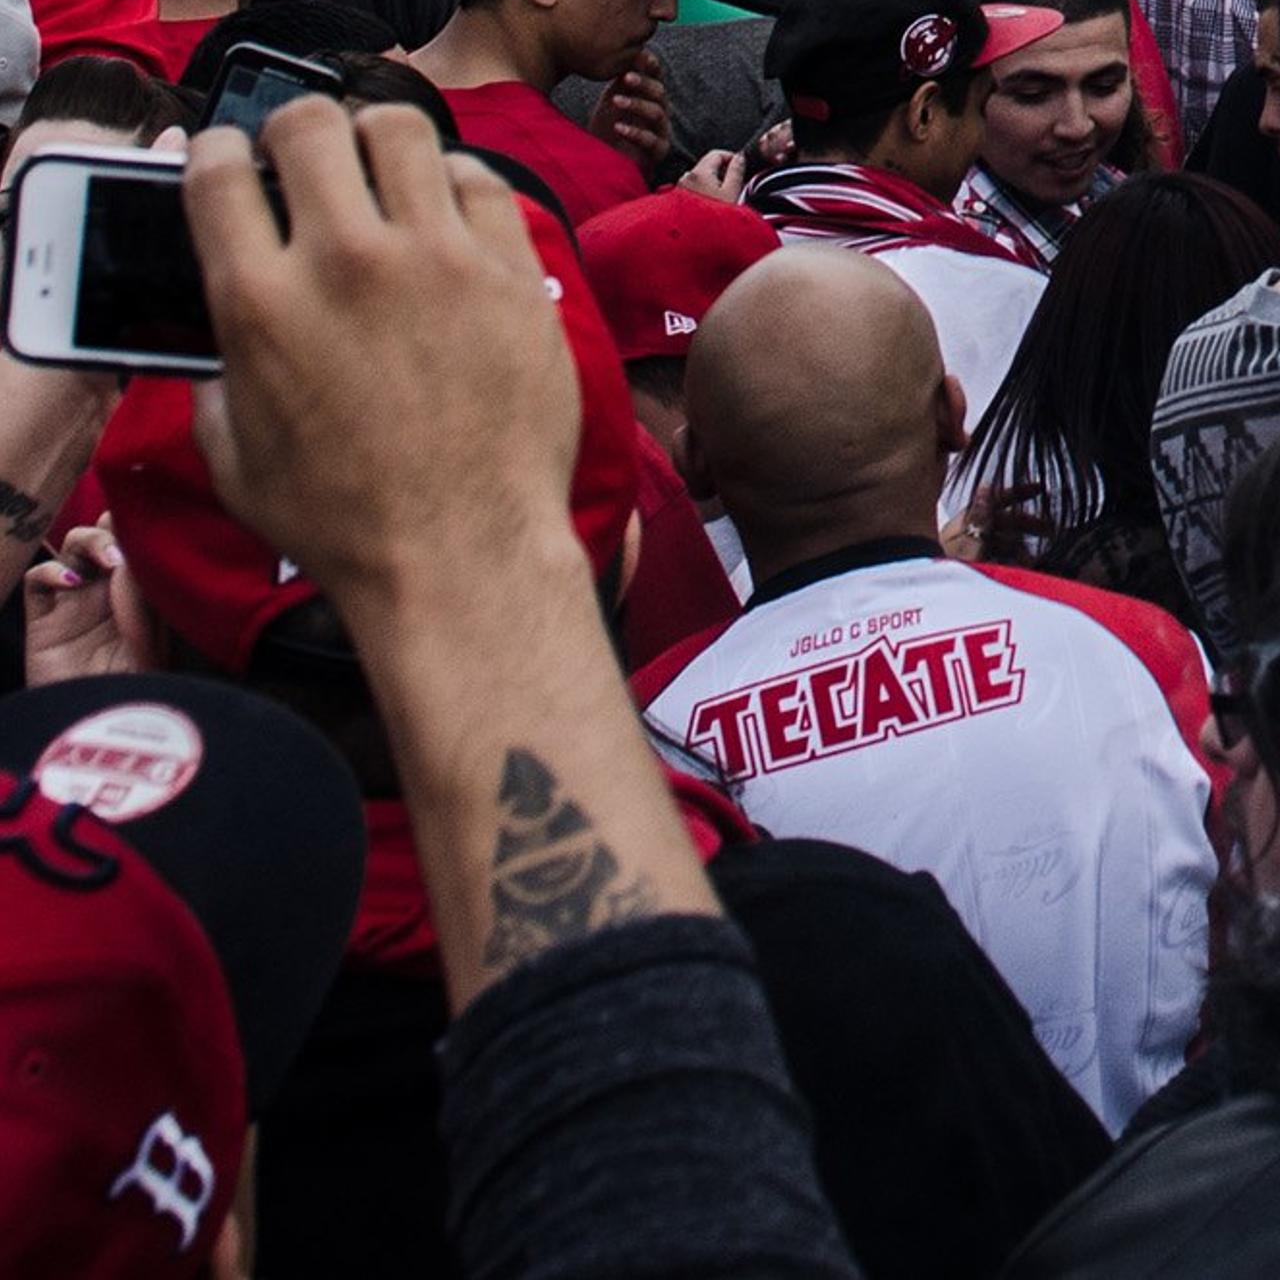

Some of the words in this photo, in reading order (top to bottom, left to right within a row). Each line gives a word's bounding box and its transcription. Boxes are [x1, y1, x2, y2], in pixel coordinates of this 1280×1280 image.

[866, 608, 923, 636] SPORT
[687, 619, 1025, 784] TECATE
[110, 1111, 216, 1248] B
